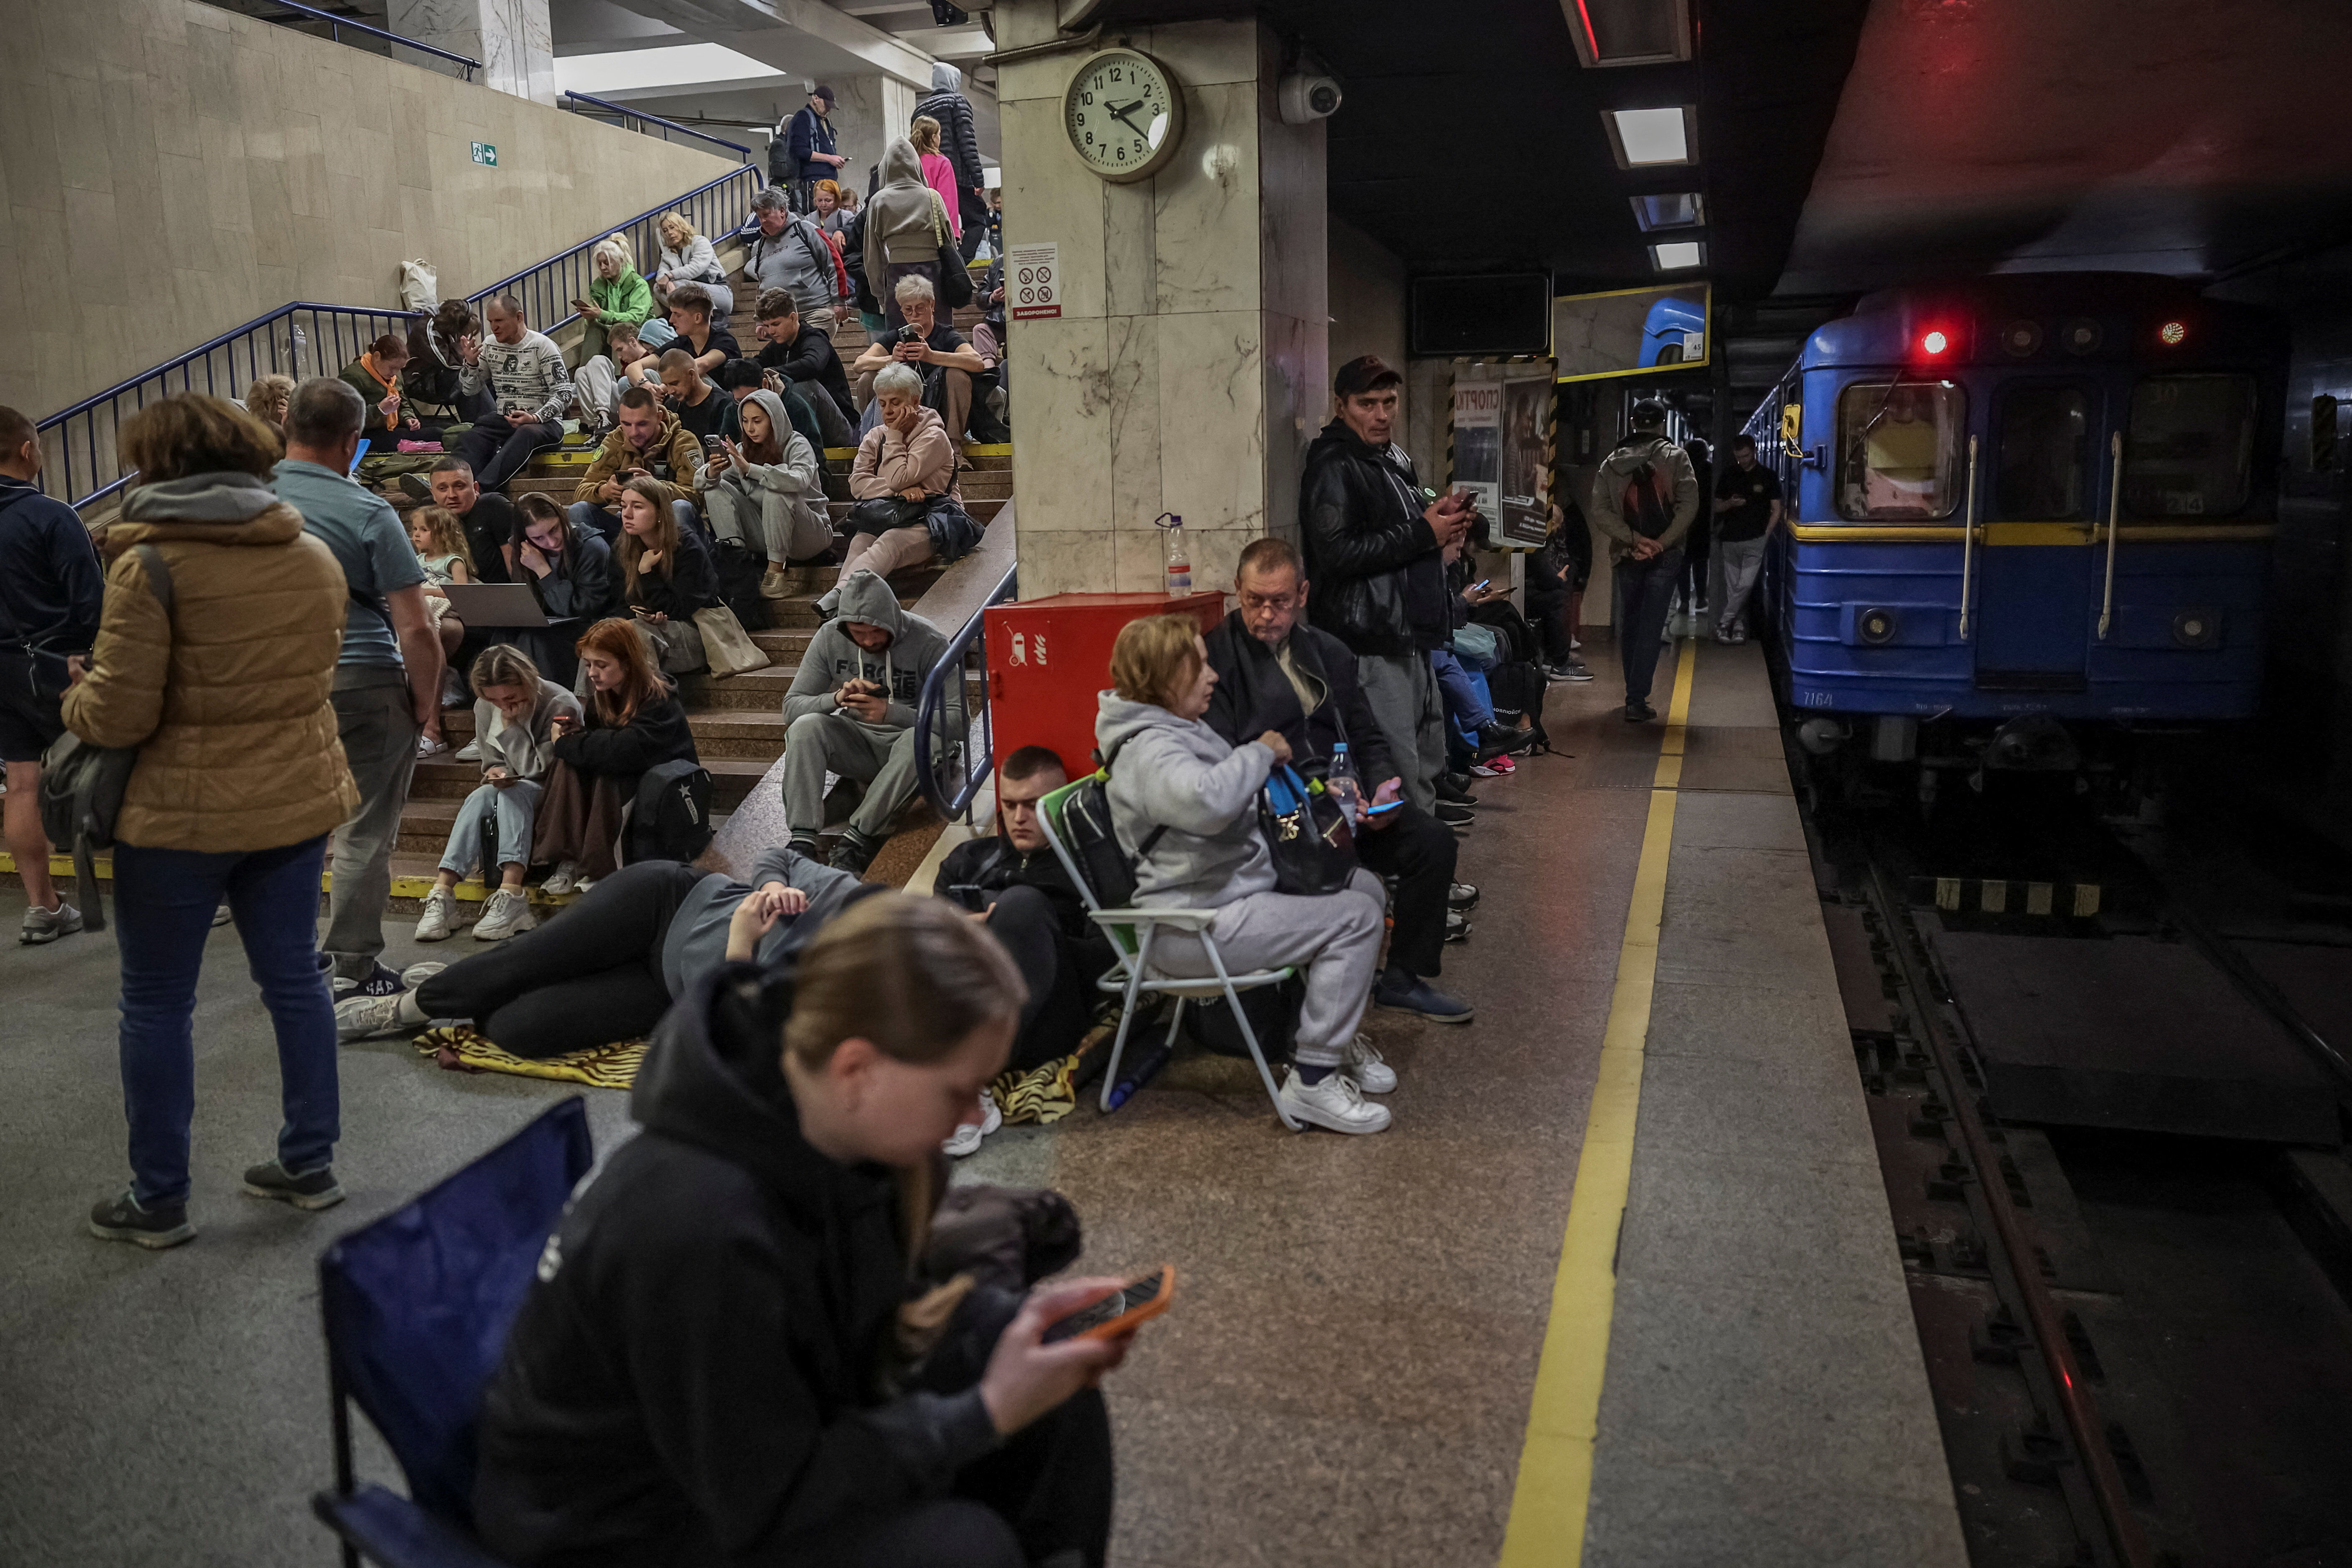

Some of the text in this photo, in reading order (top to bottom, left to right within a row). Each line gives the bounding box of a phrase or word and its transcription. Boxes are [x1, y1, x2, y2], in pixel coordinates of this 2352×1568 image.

[1109, 68, 1122, 82] 12
[1130, 70, 1135, 85] 1
[1094, 75, 1103, 90] 11
[1143, 83, 1151, 98] 2
[1081, 91, 1093, 106] 10
[1152, 103, 1160, 116] 3
[1077, 113, 1085, 126] 9
[1085, 131, 1093, 145] 8
[1099, 143, 1107, 158] 7
[1134, 139, 1142, 153] 5
[1117, 147, 1125, 160] 6
[1804, 692, 1833, 706] 7164
[366, 980, 394, 995] GAP
